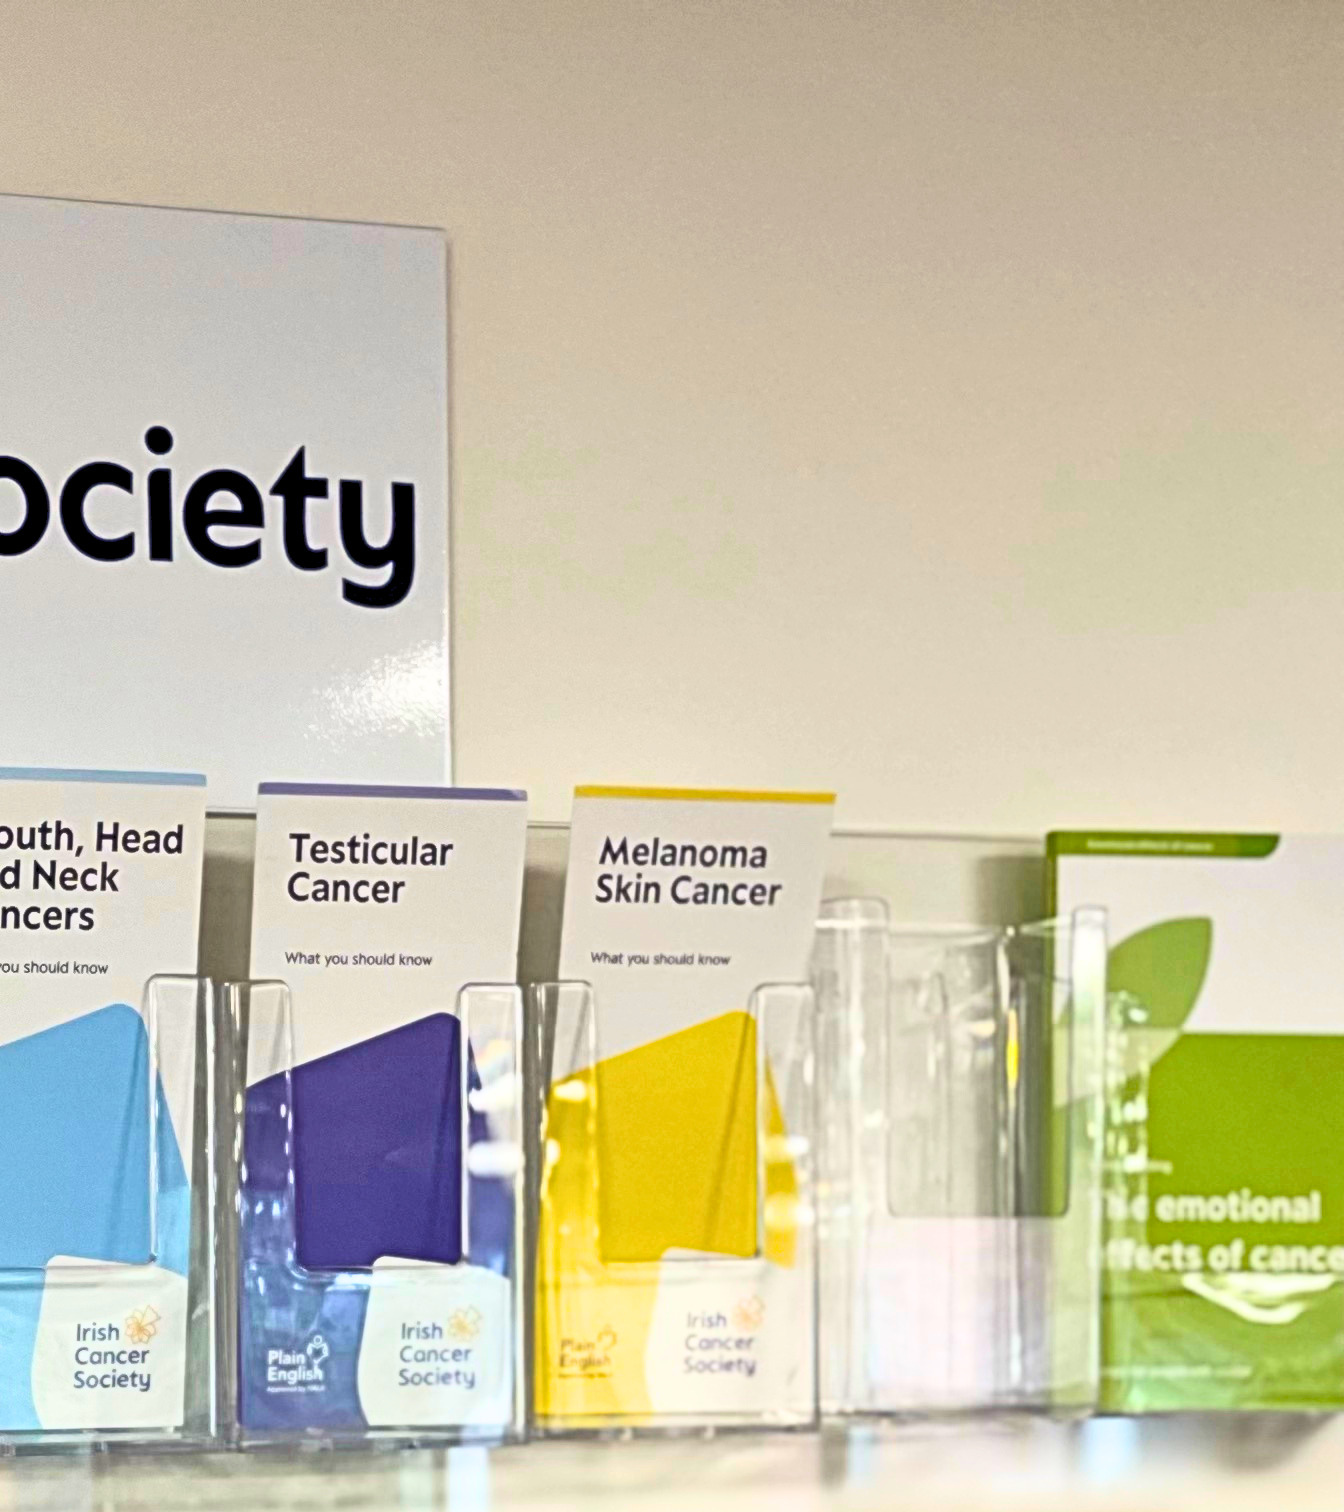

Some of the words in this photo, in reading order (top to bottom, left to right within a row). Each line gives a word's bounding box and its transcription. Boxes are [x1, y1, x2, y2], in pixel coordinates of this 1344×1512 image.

[95, 822, 184, 854] Head
[290, 833, 453, 865] Testicular
[599, 836, 768, 868] Melanoma
[32, 862, 119, 892] Neck
[287, 872, 405, 903] Cancer
[595, 874, 661, 905] Skin
[670, 877, 782, 906] Cancer
[23, 960, 70, 975] should
[73, 960, 108, 975] know
[1156, 1187, 1321, 1224] emotional
[1209, 1239, 1243, 1270] of
[76, 1323, 120, 1342] Irish
[75, 1347, 150, 1366] Cancer
[73, 1370, 152, 1392] Society
